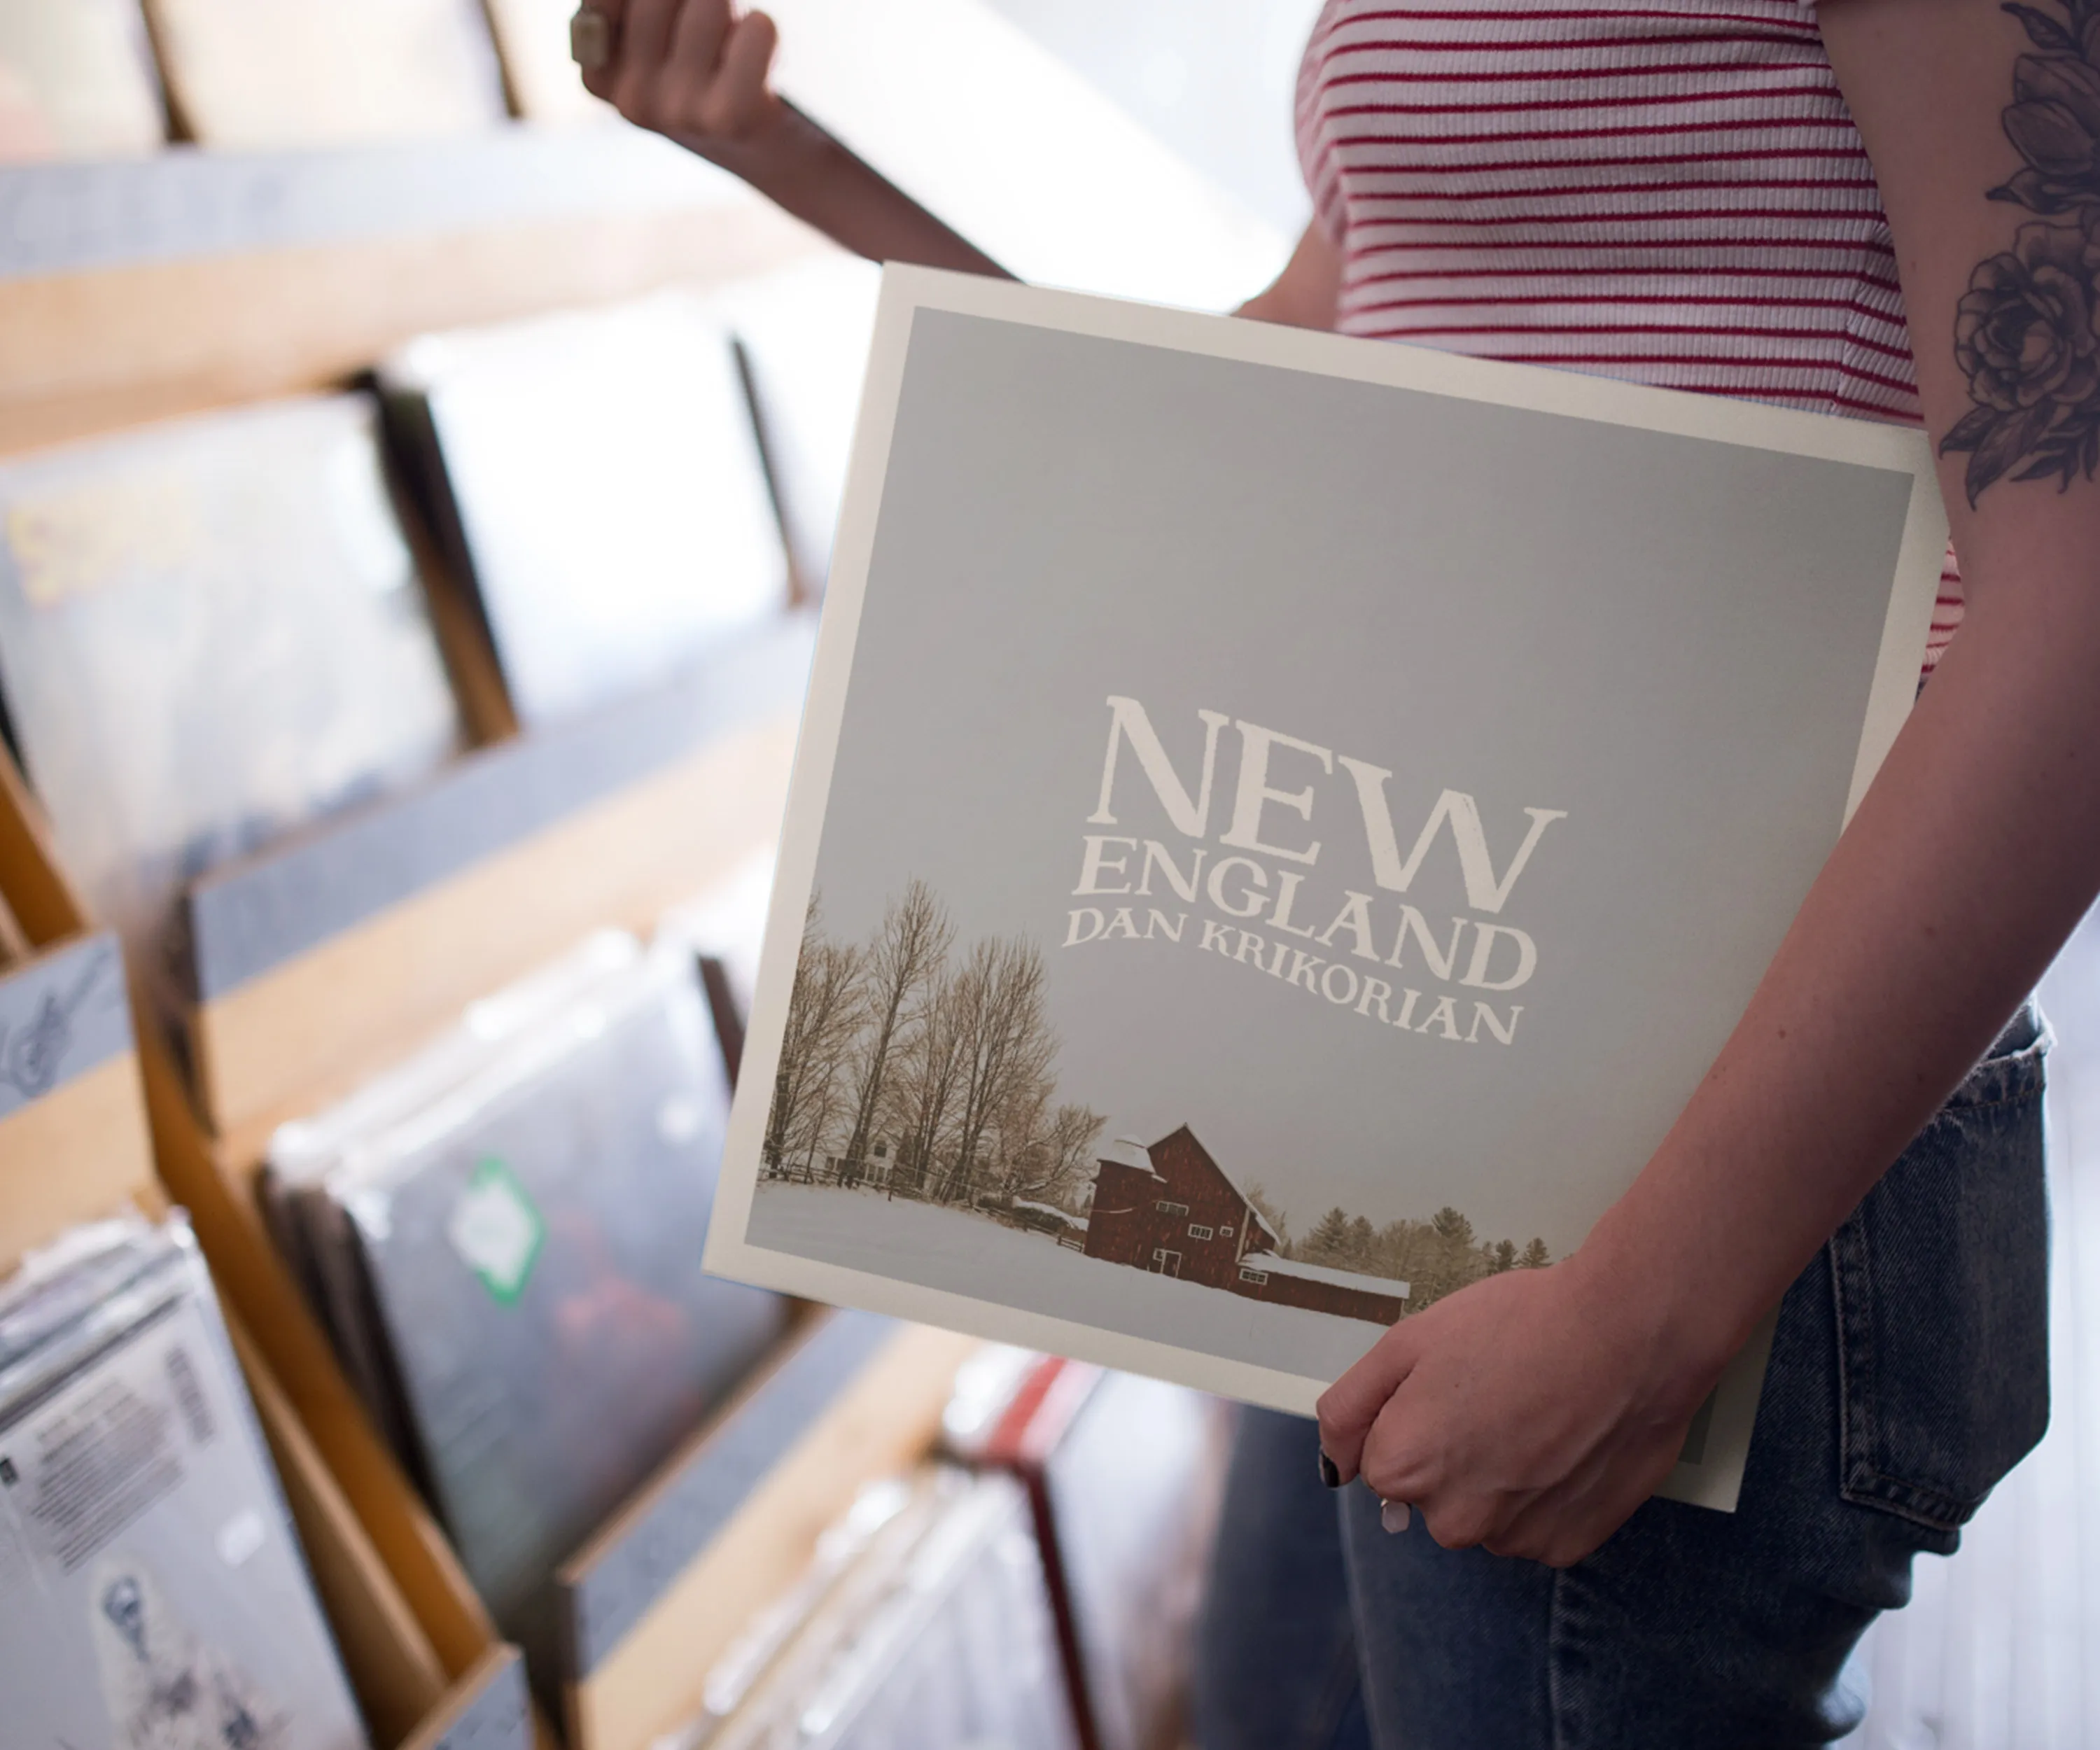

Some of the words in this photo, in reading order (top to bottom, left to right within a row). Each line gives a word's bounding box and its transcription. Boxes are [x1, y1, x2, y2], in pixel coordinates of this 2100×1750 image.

[1086, 695, 1568, 913] NEW
[1061, 907, 1188, 948] DAN
[1198, 919, 1525, 1046] KRIKORIAN
[1071, 836, 1538, 991] ENGLAND
